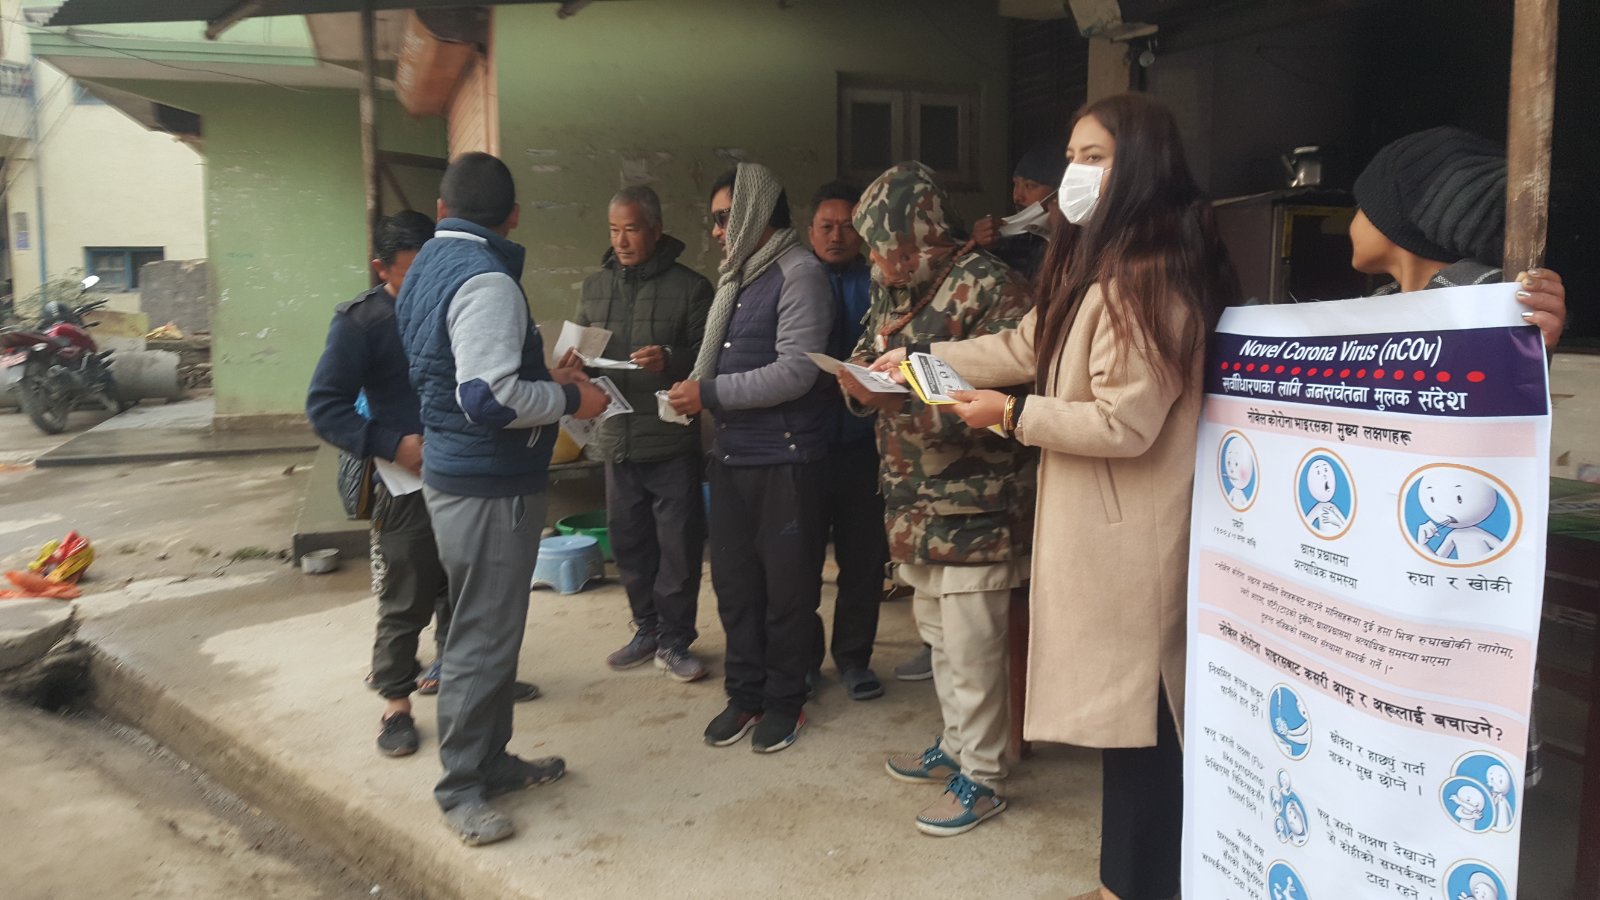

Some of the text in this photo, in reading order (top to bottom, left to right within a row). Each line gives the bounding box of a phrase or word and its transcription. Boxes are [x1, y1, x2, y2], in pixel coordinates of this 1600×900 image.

[1239, 339, 1287, 359] Novel
[1283, 341, 1338, 361] Corona
[1339, 341, 1379, 362] Virus
[1278, 377, 1303, 397] लागि
[1305, 381, 1370, 404] जनसचेतना
[1373, 387, 1412, 411] मुलक
[1418, 386, 1468, 412] संदेश
[1267, 409, 1293, 429] कोरोना
[1294, 417, 1333, 435] भाइरसका
[1336, 422, 1359, 442] मुख्य
[1446, 577, 1459, 590] र
[1466, 573, 1512, 594] खोकी
[1395, 628, 1415, 643] भित्र
[1387, 647, 1419, 663] समस्या
[1421, 655, 1452, 668] भएमा
[1303, 666, 1329, 689] कसरी
[1358, 692, 1368, 708] र
[1357, 745, 1364, 757] र
[1401, 761, 1425, 776] गर्दा
[1393, 841, 1437, 869] देखाउने
[1395, 883, 1420, 900] रहने
